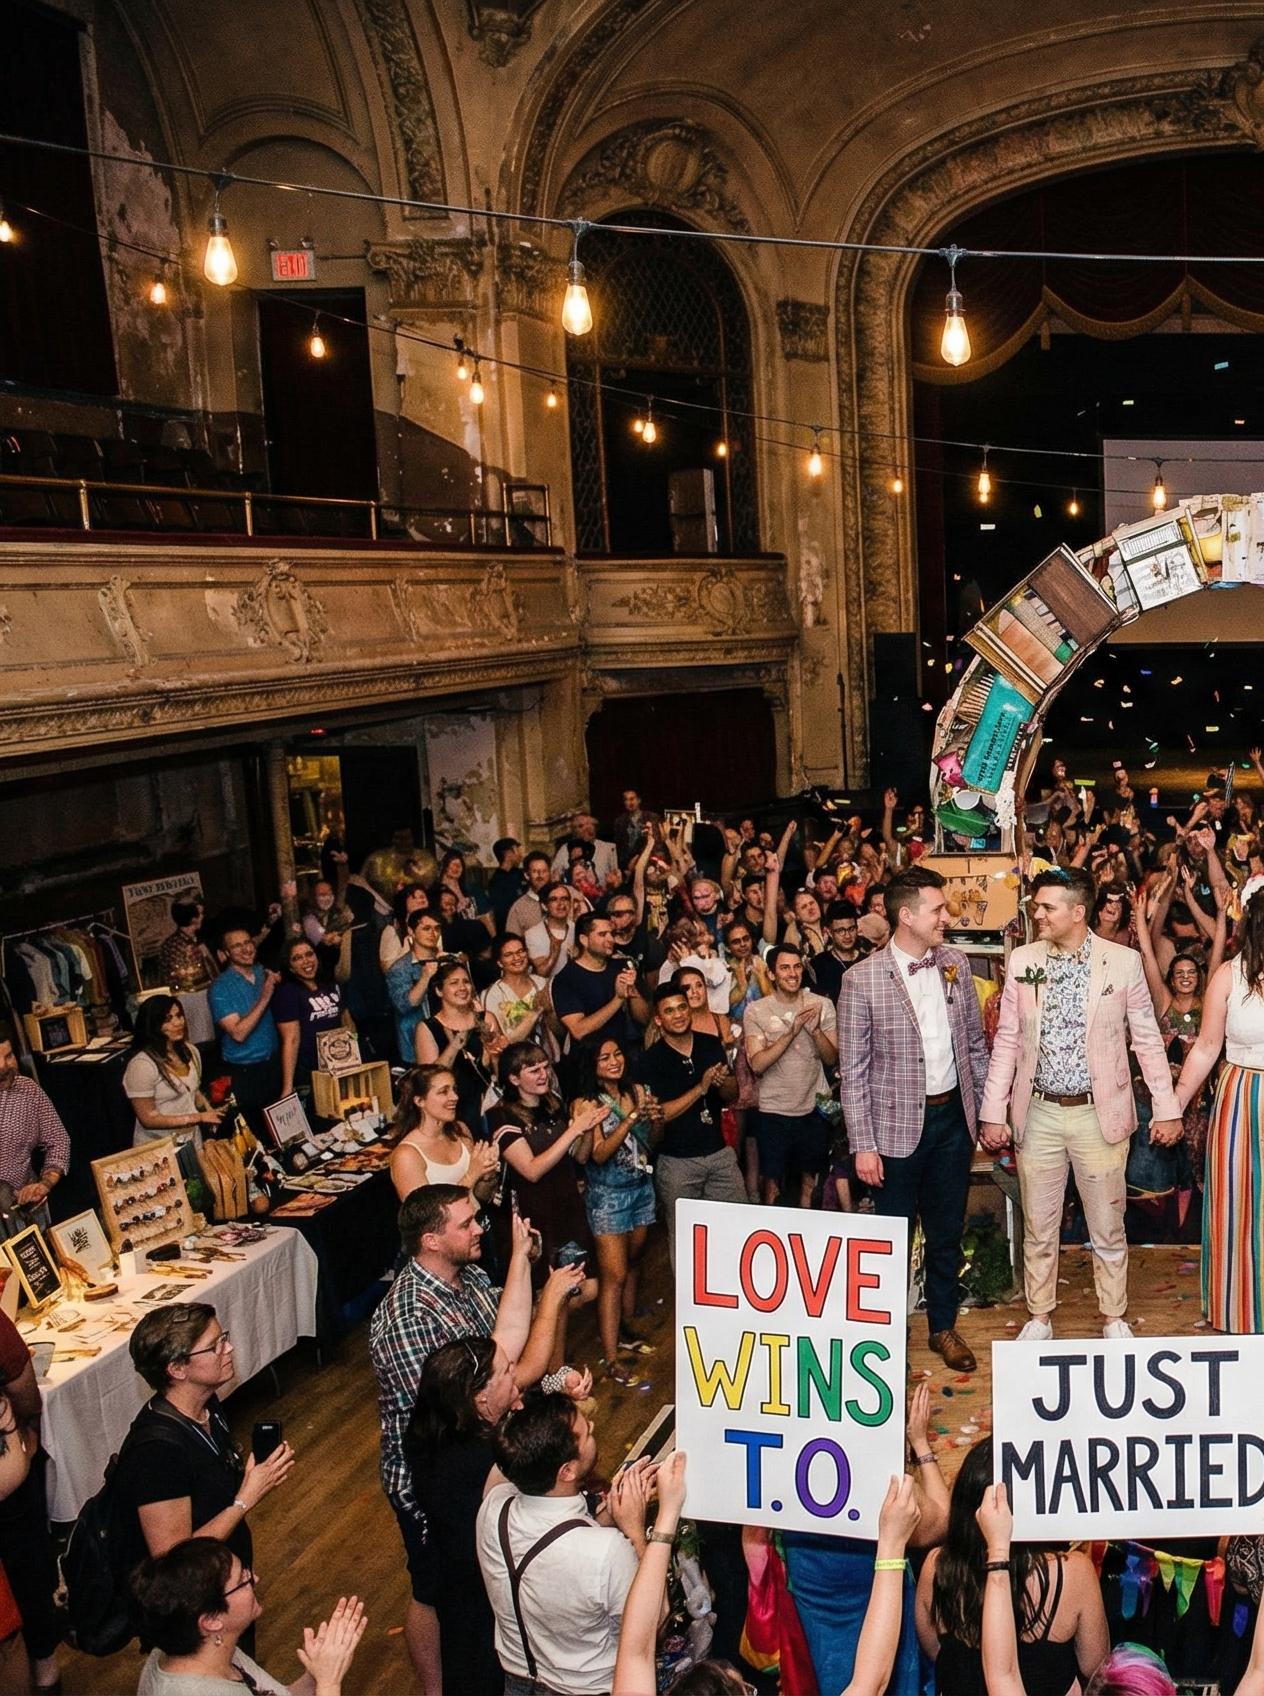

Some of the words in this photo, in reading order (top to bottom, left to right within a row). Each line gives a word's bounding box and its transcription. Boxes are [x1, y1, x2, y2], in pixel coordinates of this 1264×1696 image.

[692, 1223, 893, 1325] LOVE
[683, 1326, 893, 1428] WINS
[1031, 1349, 1239, 1421] JUST
[723, 1428, 860, 1522] T.O.
